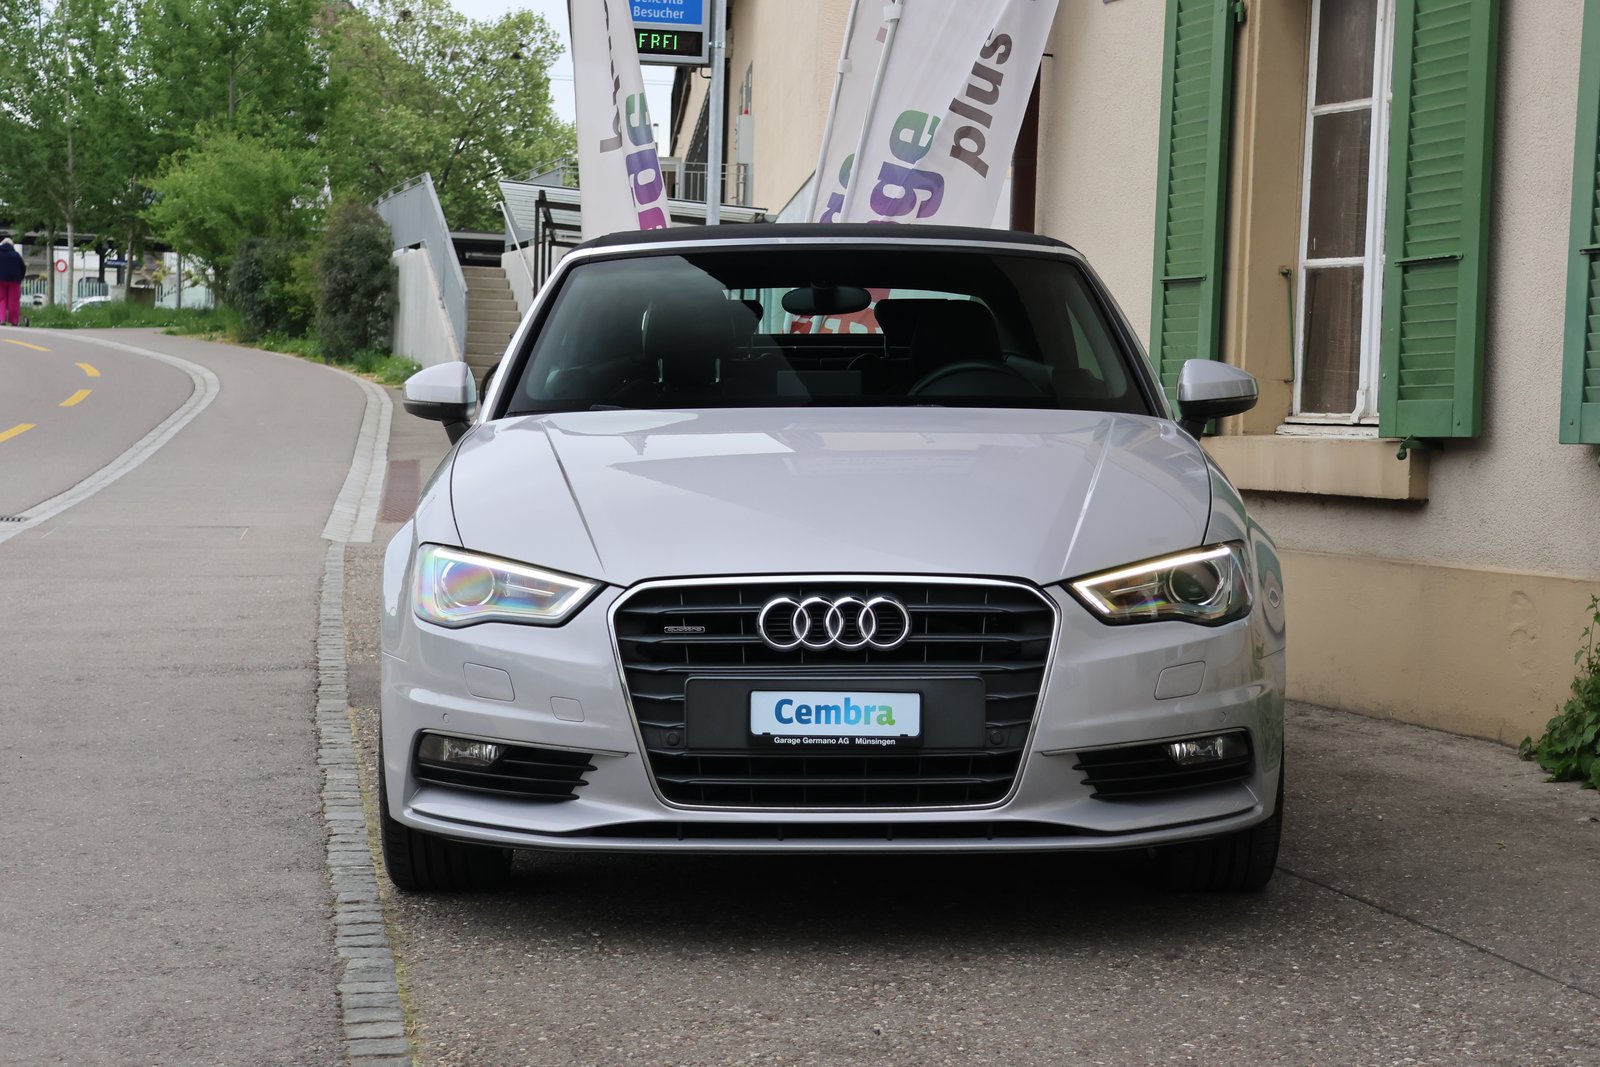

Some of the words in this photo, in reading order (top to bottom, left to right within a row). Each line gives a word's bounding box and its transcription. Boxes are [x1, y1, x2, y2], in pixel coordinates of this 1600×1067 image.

[633, 6, 685, 19] Besucher
[949, 29, 1012, 179] plus
[774, 697, 896, 726] Cembra
[774, 736, 801, 746] Garage
[802, 737, 837, 745] Germano
[837, 737, 850, 745] AG
[855, 737, 896, 747] Münsingen
